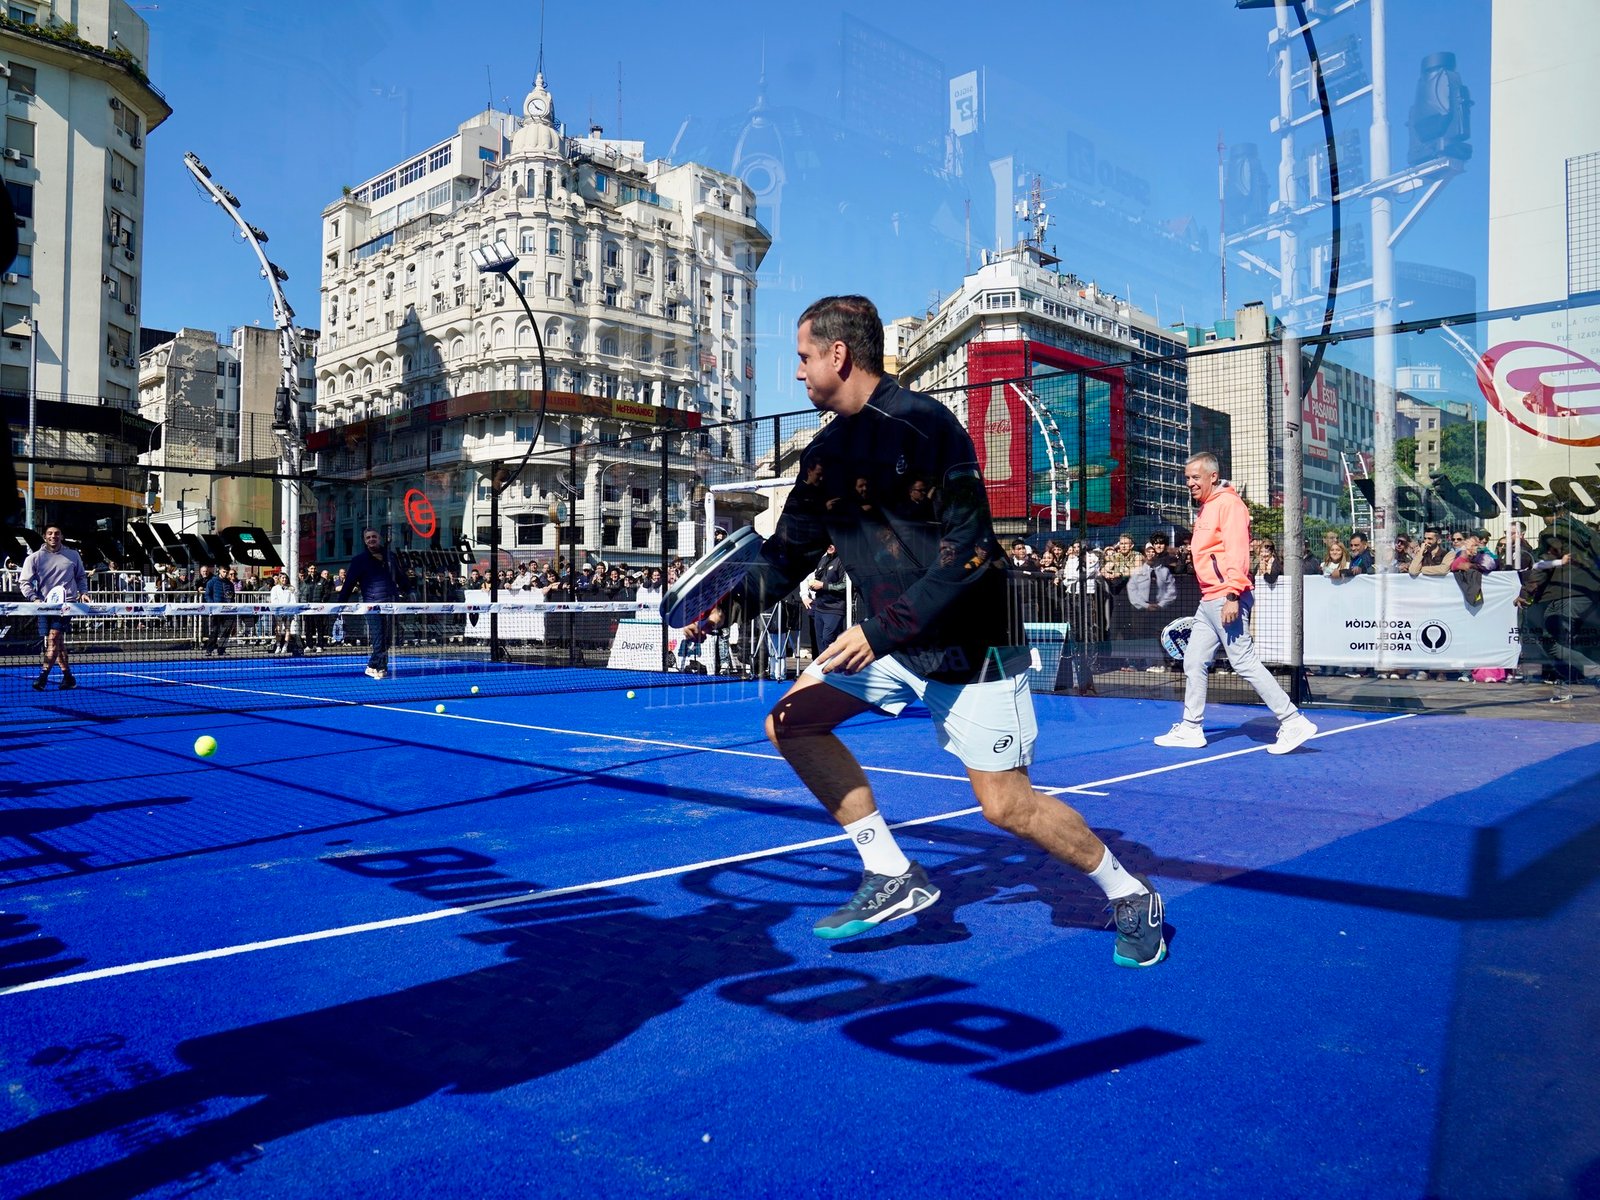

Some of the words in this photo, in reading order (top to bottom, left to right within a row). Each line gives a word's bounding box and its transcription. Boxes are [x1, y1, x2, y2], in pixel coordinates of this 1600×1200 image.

[1322, 387, 1337, 407] ESTÁ
[1311, 400, 1338, 423] PASANDO
[621, 641, 654, 651] Deportes
